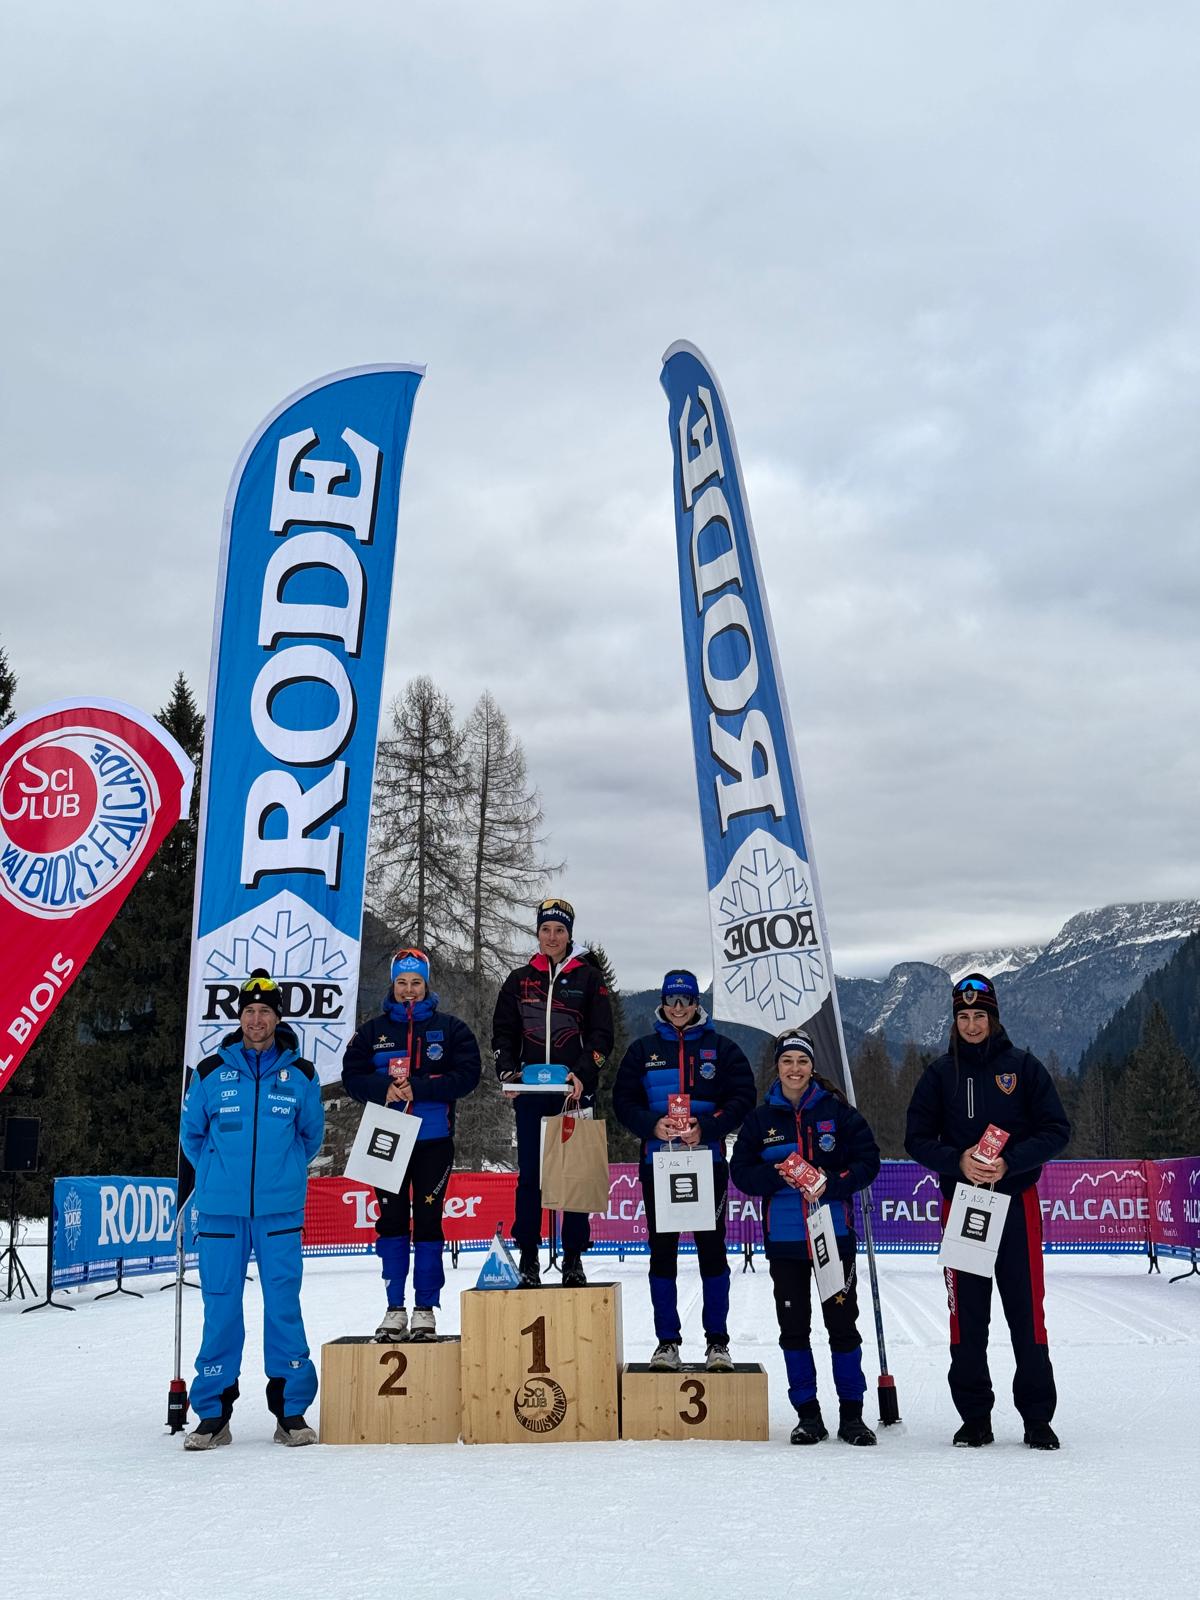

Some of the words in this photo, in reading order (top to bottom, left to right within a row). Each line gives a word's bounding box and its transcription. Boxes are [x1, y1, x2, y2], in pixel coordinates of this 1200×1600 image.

[240, 427, 383, 890] RODE
[7, 952, 74, 1045] BIOIS
[202, 982, 344, 1021] RDE
[220, 1070, 239, 1080] EA7
[268, 1094, 297, 1103] FALCONERI
[272, 1106, 291, 1115] enel
[98, 1184, 177, 1246] RODE
[881, 1200, 940, 1222] FALC
[1039, 1198, 1150, 1221] FALCADE
[1099, 1224, 1152, 1234] Dolomiti
[520, 1315, 551, 1374] 1
[204, 1365, 223, 1375] EA7
[377, 1350, 408, 1396] 2
[679, 1379, 708, 1425] 3
